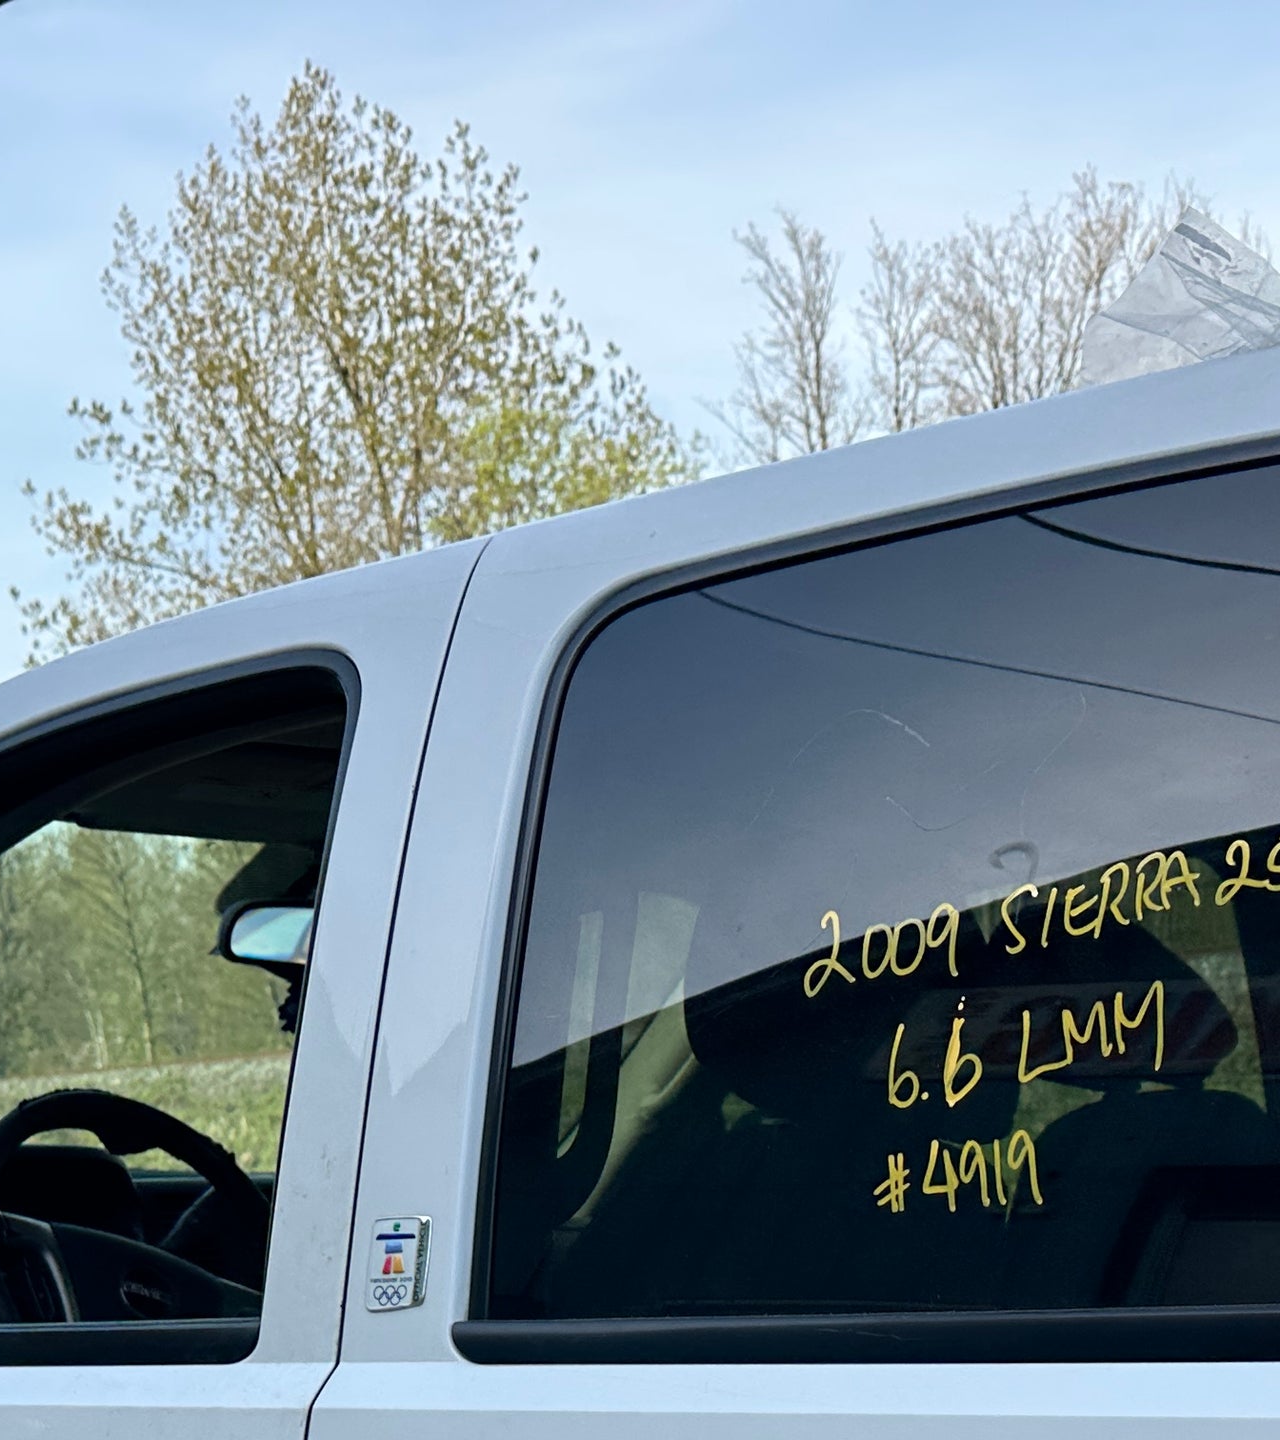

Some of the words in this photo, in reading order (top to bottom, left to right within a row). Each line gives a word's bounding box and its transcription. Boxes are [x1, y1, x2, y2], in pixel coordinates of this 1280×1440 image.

[804, 903, 960, 998] 2009
[1005, 850, 1200, 955] SIERRA
[888, 1010, 983, 1108] 6.6
[1018, 980, 1166, 1084] LMM
[873, 1129, 1044, 1213] #4919
